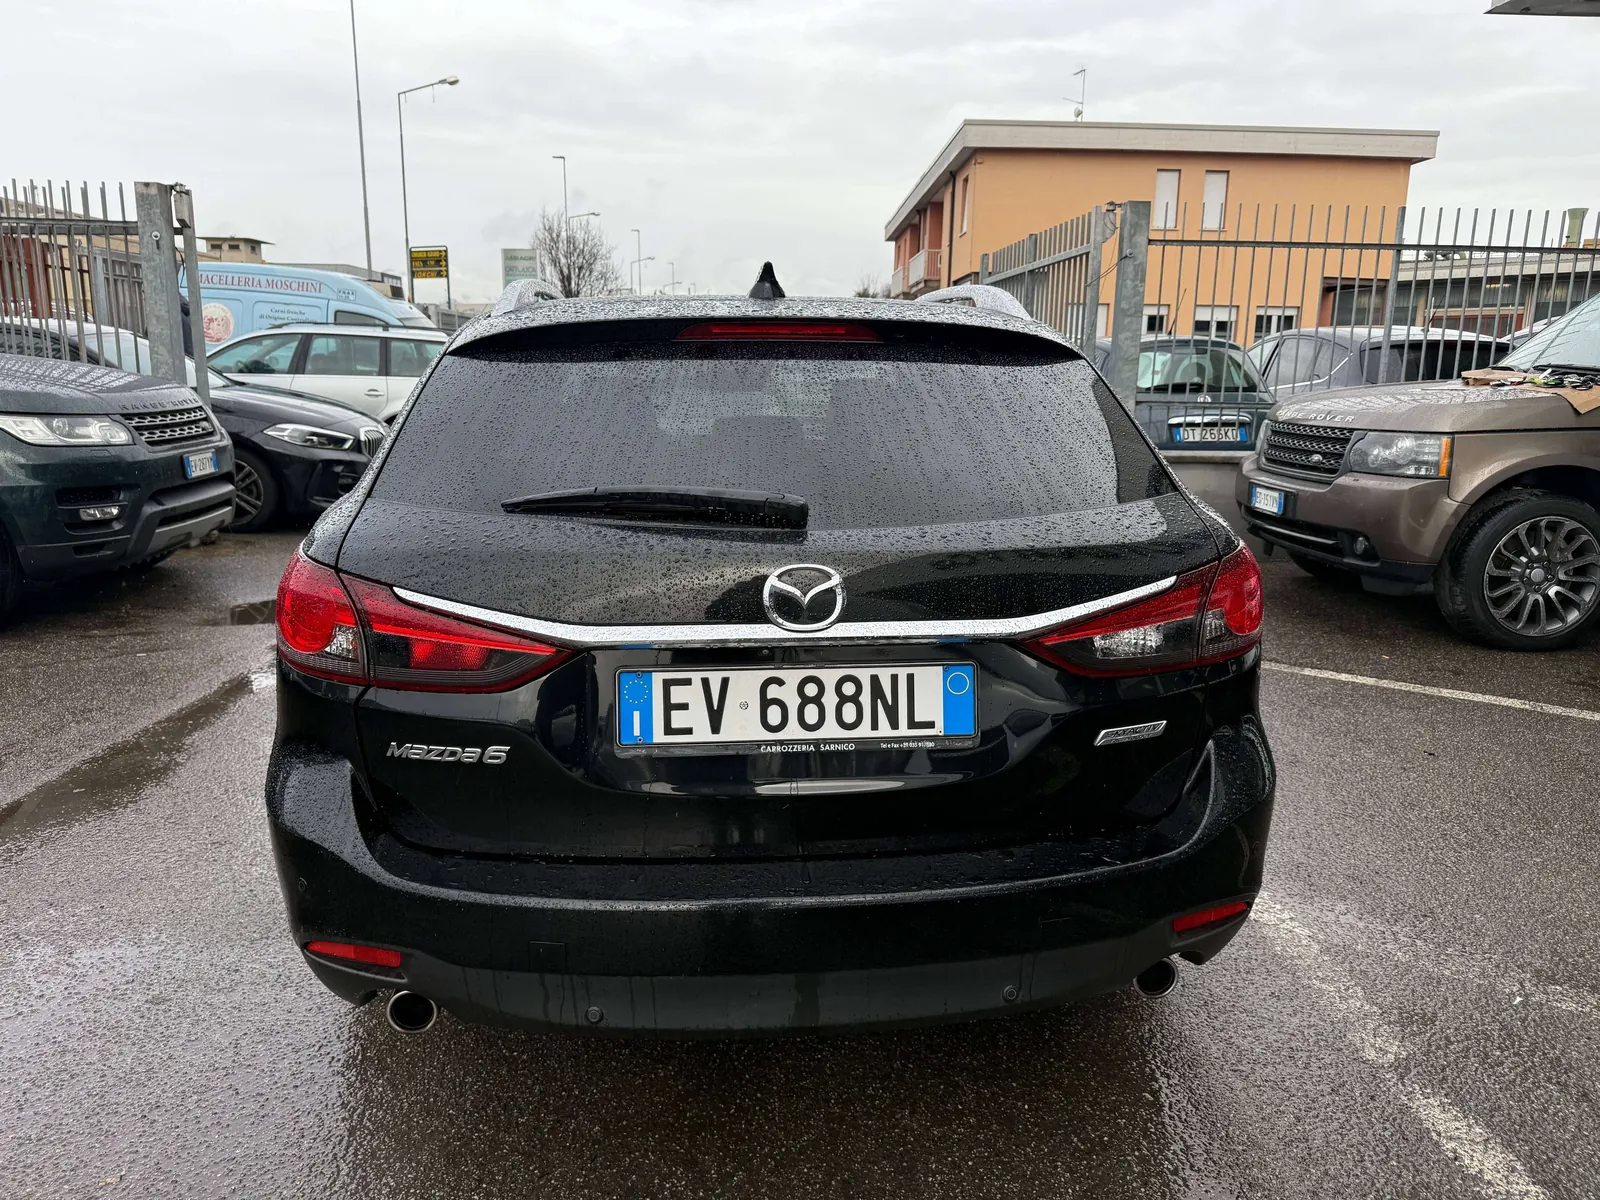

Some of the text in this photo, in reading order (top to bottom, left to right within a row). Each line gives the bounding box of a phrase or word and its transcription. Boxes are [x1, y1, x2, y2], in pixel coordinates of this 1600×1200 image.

[265, 279, 322, 293] MOSCHINI
[1308, 413, 1355, 423] ROVER
[662, 672, 936, 736] EV 688NL
[760, 743, 856, 753] CARROZZERIA SARNICO
